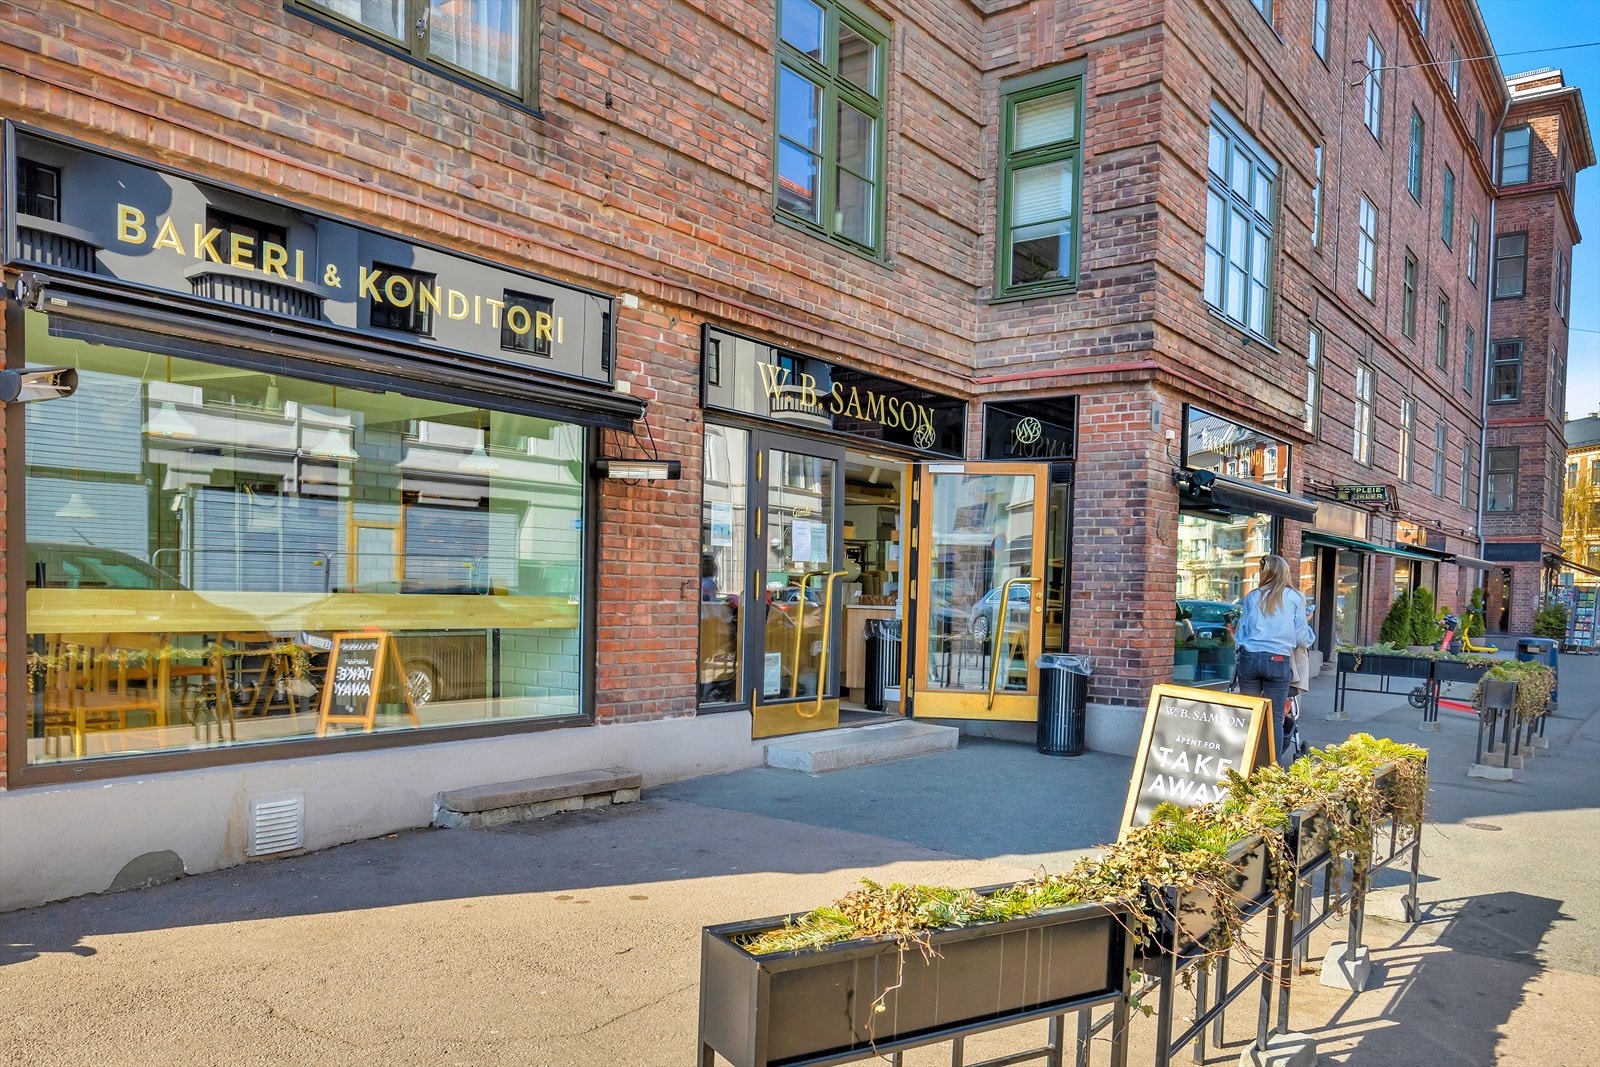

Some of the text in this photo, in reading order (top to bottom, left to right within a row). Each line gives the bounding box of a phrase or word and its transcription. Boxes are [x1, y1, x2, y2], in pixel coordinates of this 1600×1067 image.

[116, 202, 565, 344] BAKERI & KONDITORI
[756, 361, 935, 431] W. B. SAMSON
[1193, 711, 1245, 727] SAMSON
[1175, 735, 1222, 751] ÅPENT FOR
[1159, 747, 1232, 779] TAKE
[1148, 775, 1228, 802] AWAY
